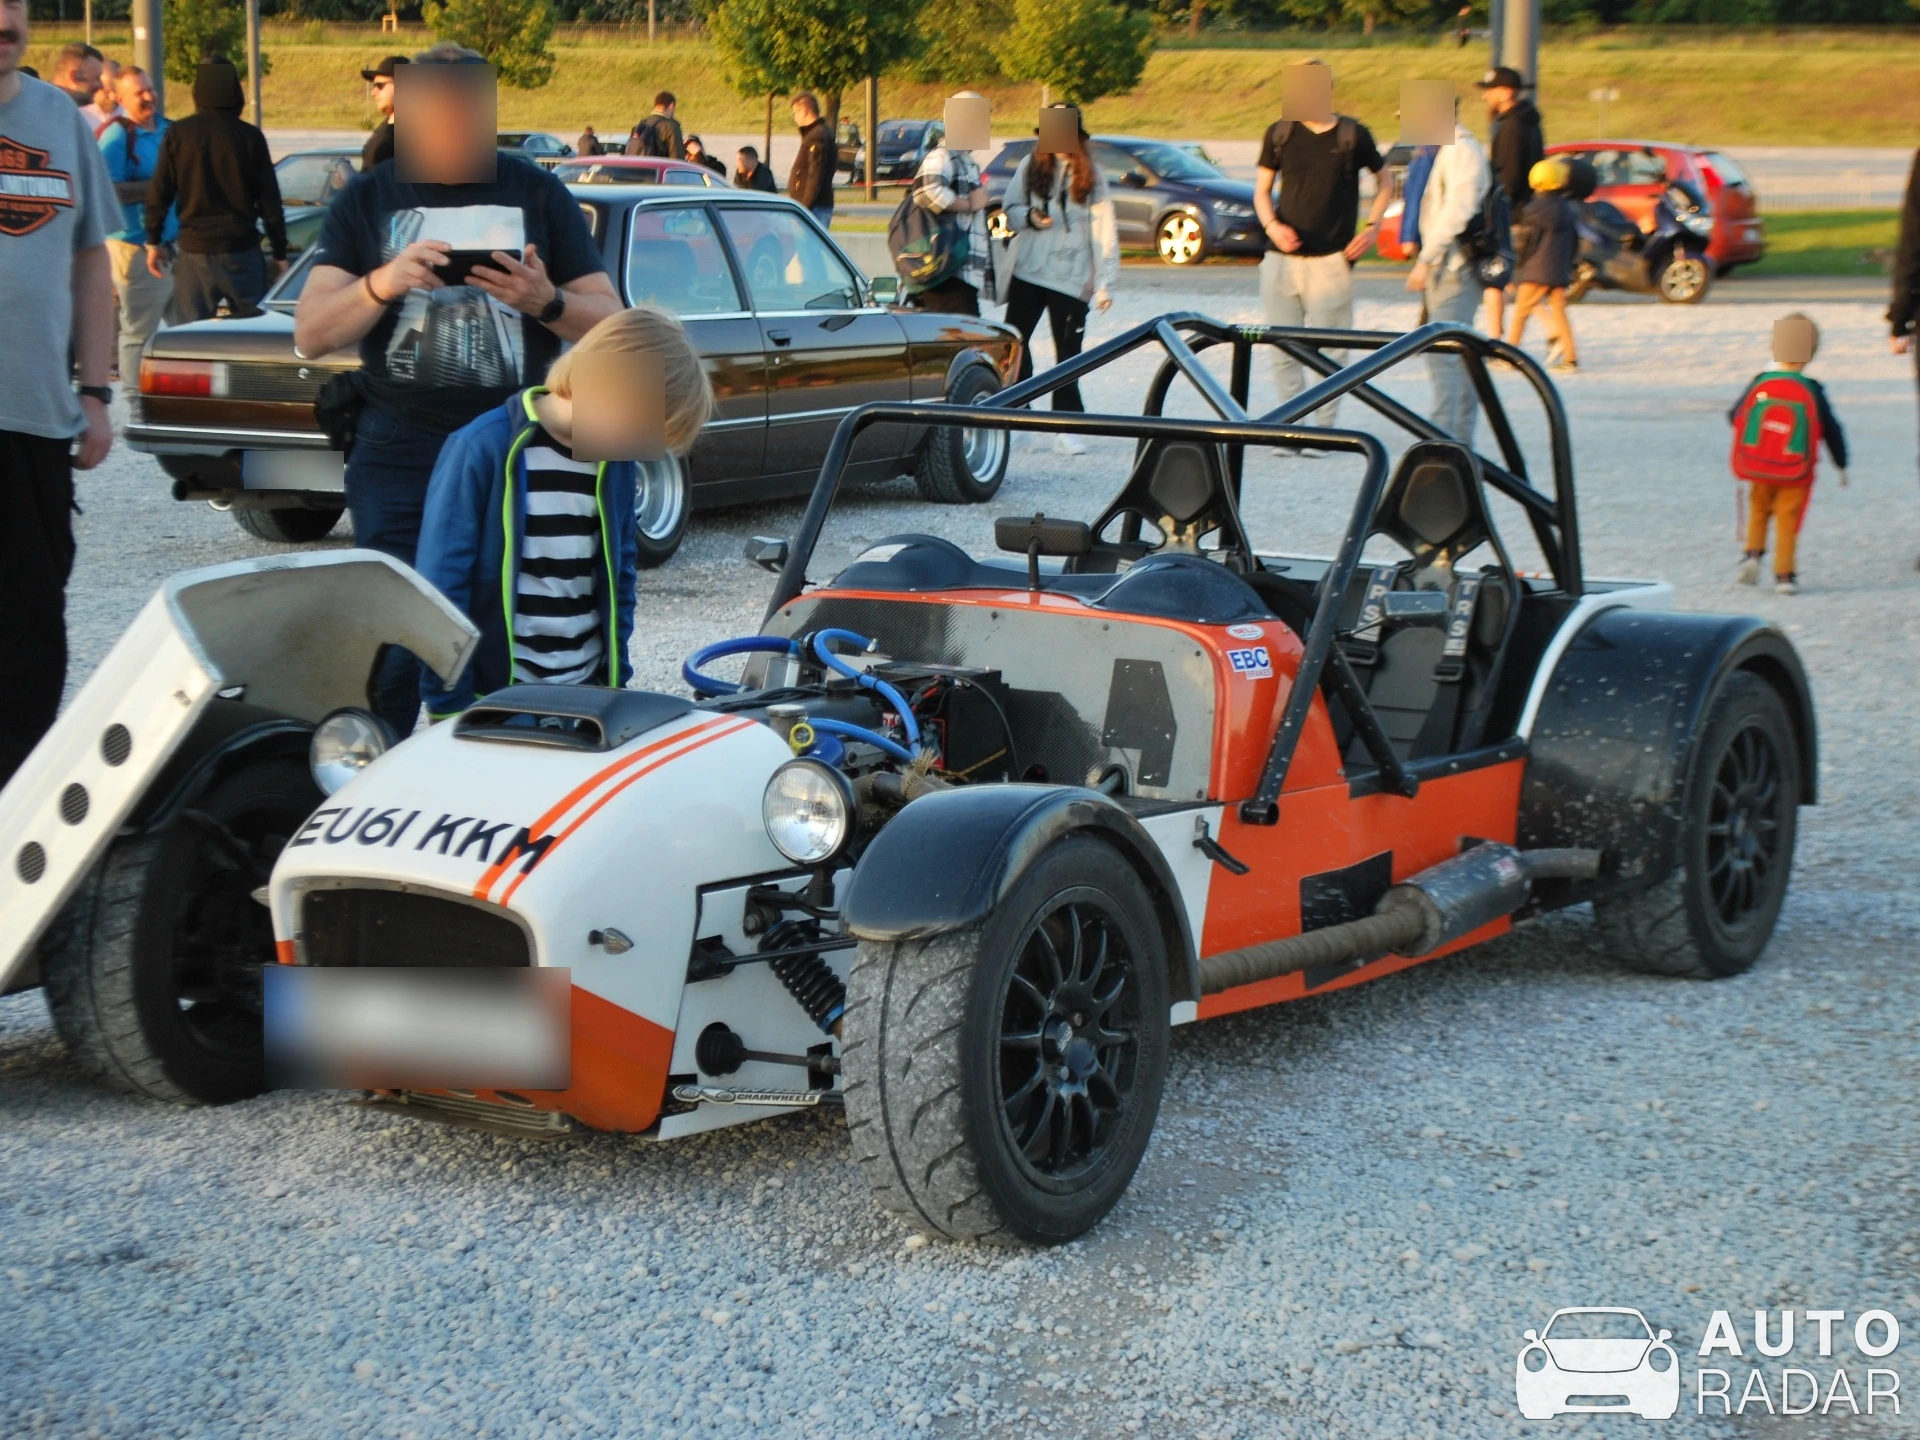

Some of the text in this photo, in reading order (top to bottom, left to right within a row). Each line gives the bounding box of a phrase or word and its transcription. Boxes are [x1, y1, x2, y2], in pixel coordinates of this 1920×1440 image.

[1450, 580, 1477, 637] TRS
[1229, 649, 1269, 670] EBC
[1246, 668, 1272, 678] BRAKES
[289, 807, 557, 875] EU61 KKM
[737, 1093, 817, 1101] CHAINWHEELS
